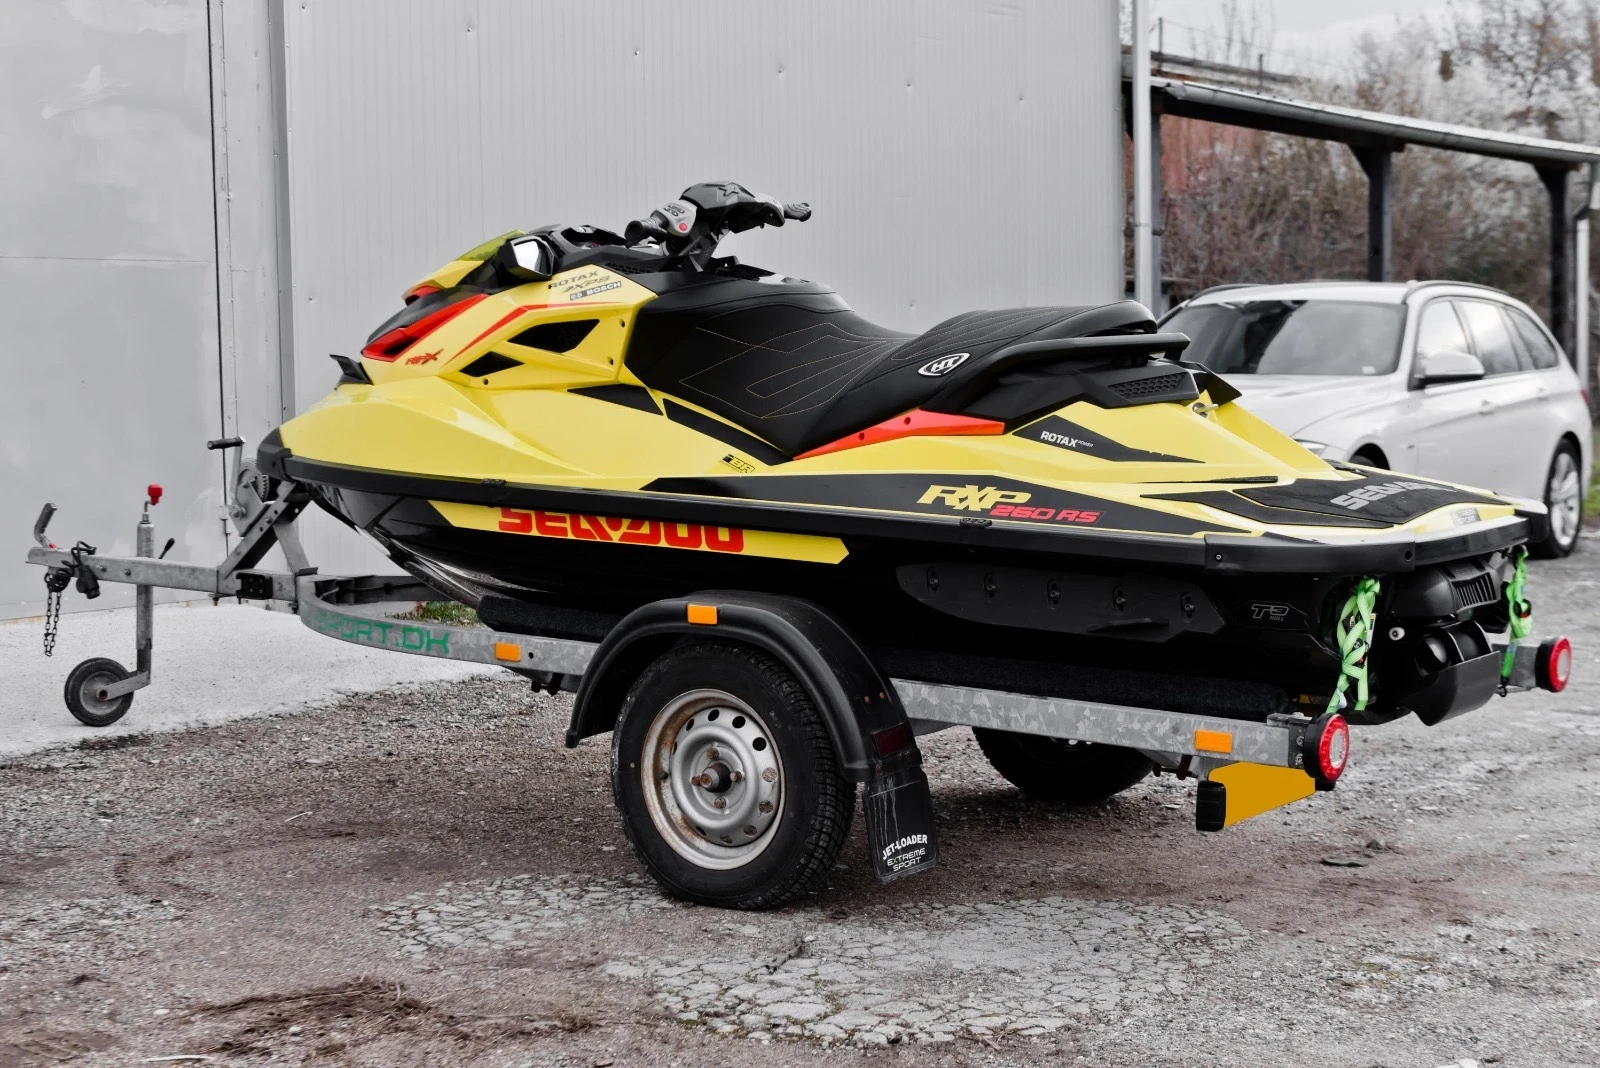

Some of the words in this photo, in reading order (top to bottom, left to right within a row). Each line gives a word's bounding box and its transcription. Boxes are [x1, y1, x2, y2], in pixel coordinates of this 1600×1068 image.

[548, 271, 598, 289] ROTAX
[586, 281, 621, 296] BOSCH
[930, 356, 959, 373] HT
[1040, 431, 1078, 448] ROTAX
[916, 485, 1032, 511] RXP
[990, 504, 1055, 521] 260
[1056, 508, 1101, 523] RS
[882, 834, 928, 860] JET-LOADER
[887, 848, 926, 866] EXTREME
[892, 857, 921, 872] SPORT
